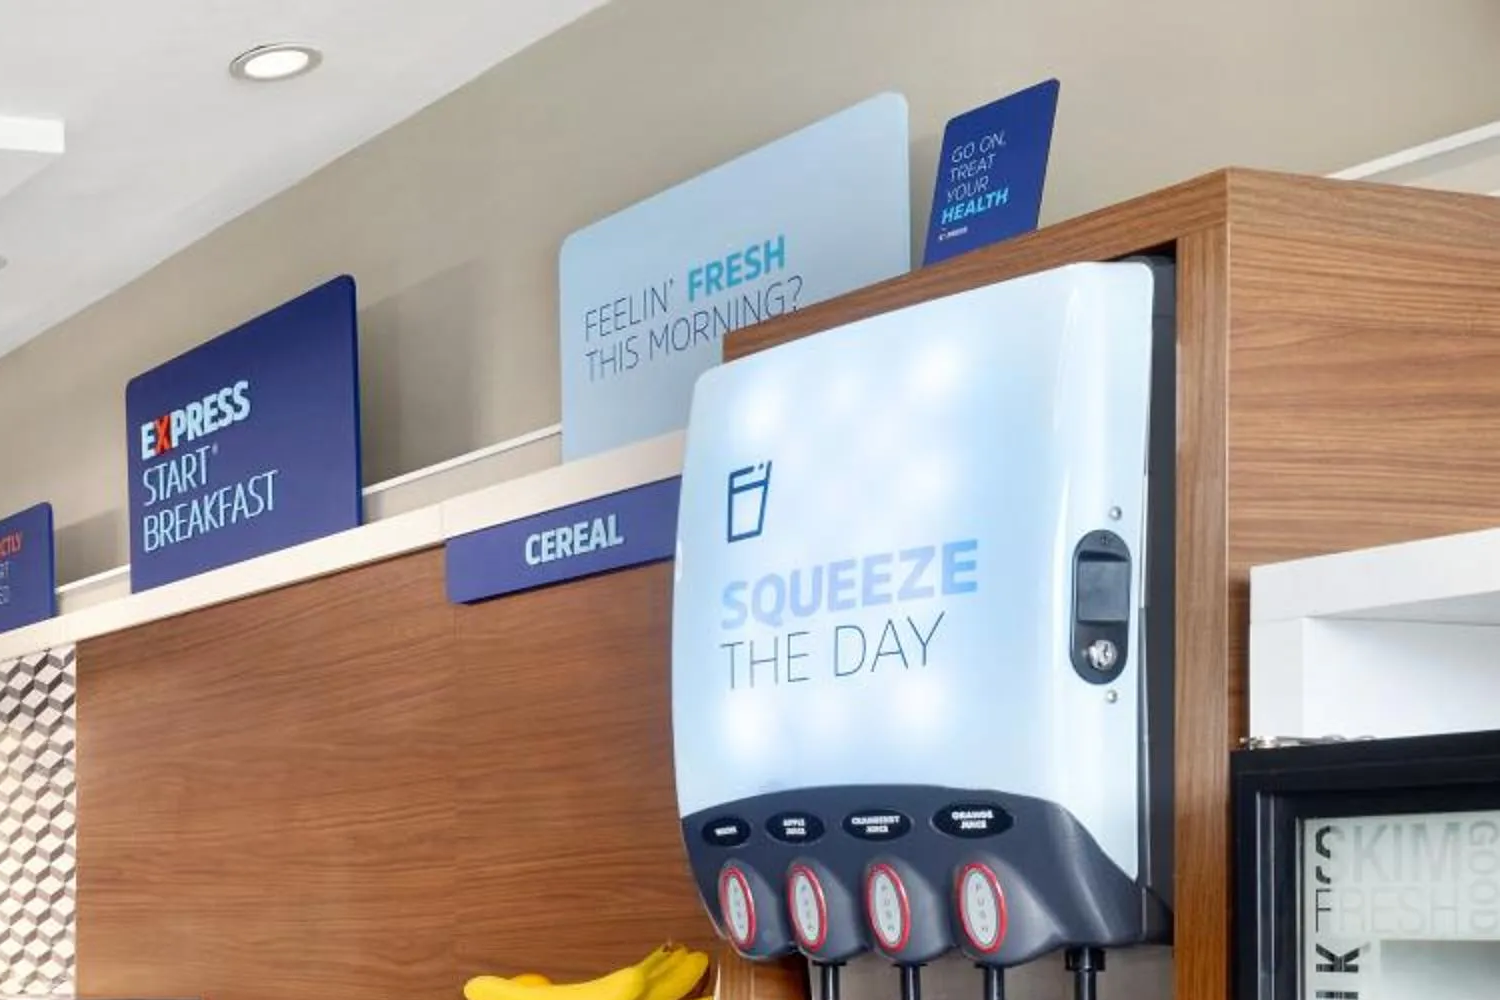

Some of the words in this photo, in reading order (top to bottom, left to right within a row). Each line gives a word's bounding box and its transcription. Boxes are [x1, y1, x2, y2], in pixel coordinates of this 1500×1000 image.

[951, 153, 997, 182] TREAT
[952, 143, 975, 163] GO
[941, 188, 1009, 225] HEALTH
[947, 175, 989, 203] YOUR
[687, 234, 786, 303] FRESH
[585, 336, 640, 383] THIS
[649, 274, 805, 362] MORNING?
[140, 380, 251, 460] EXPRESS
[143, 444, 211, 507] START
[143, 468, 278, 553] BREAKFAST
[524, 514, 624, 566] CEREAL
[720, 539, 979, 631] SQUEEZE
[720, 631, 811, 690] THE
[835, 611, 946, 678] DAY
